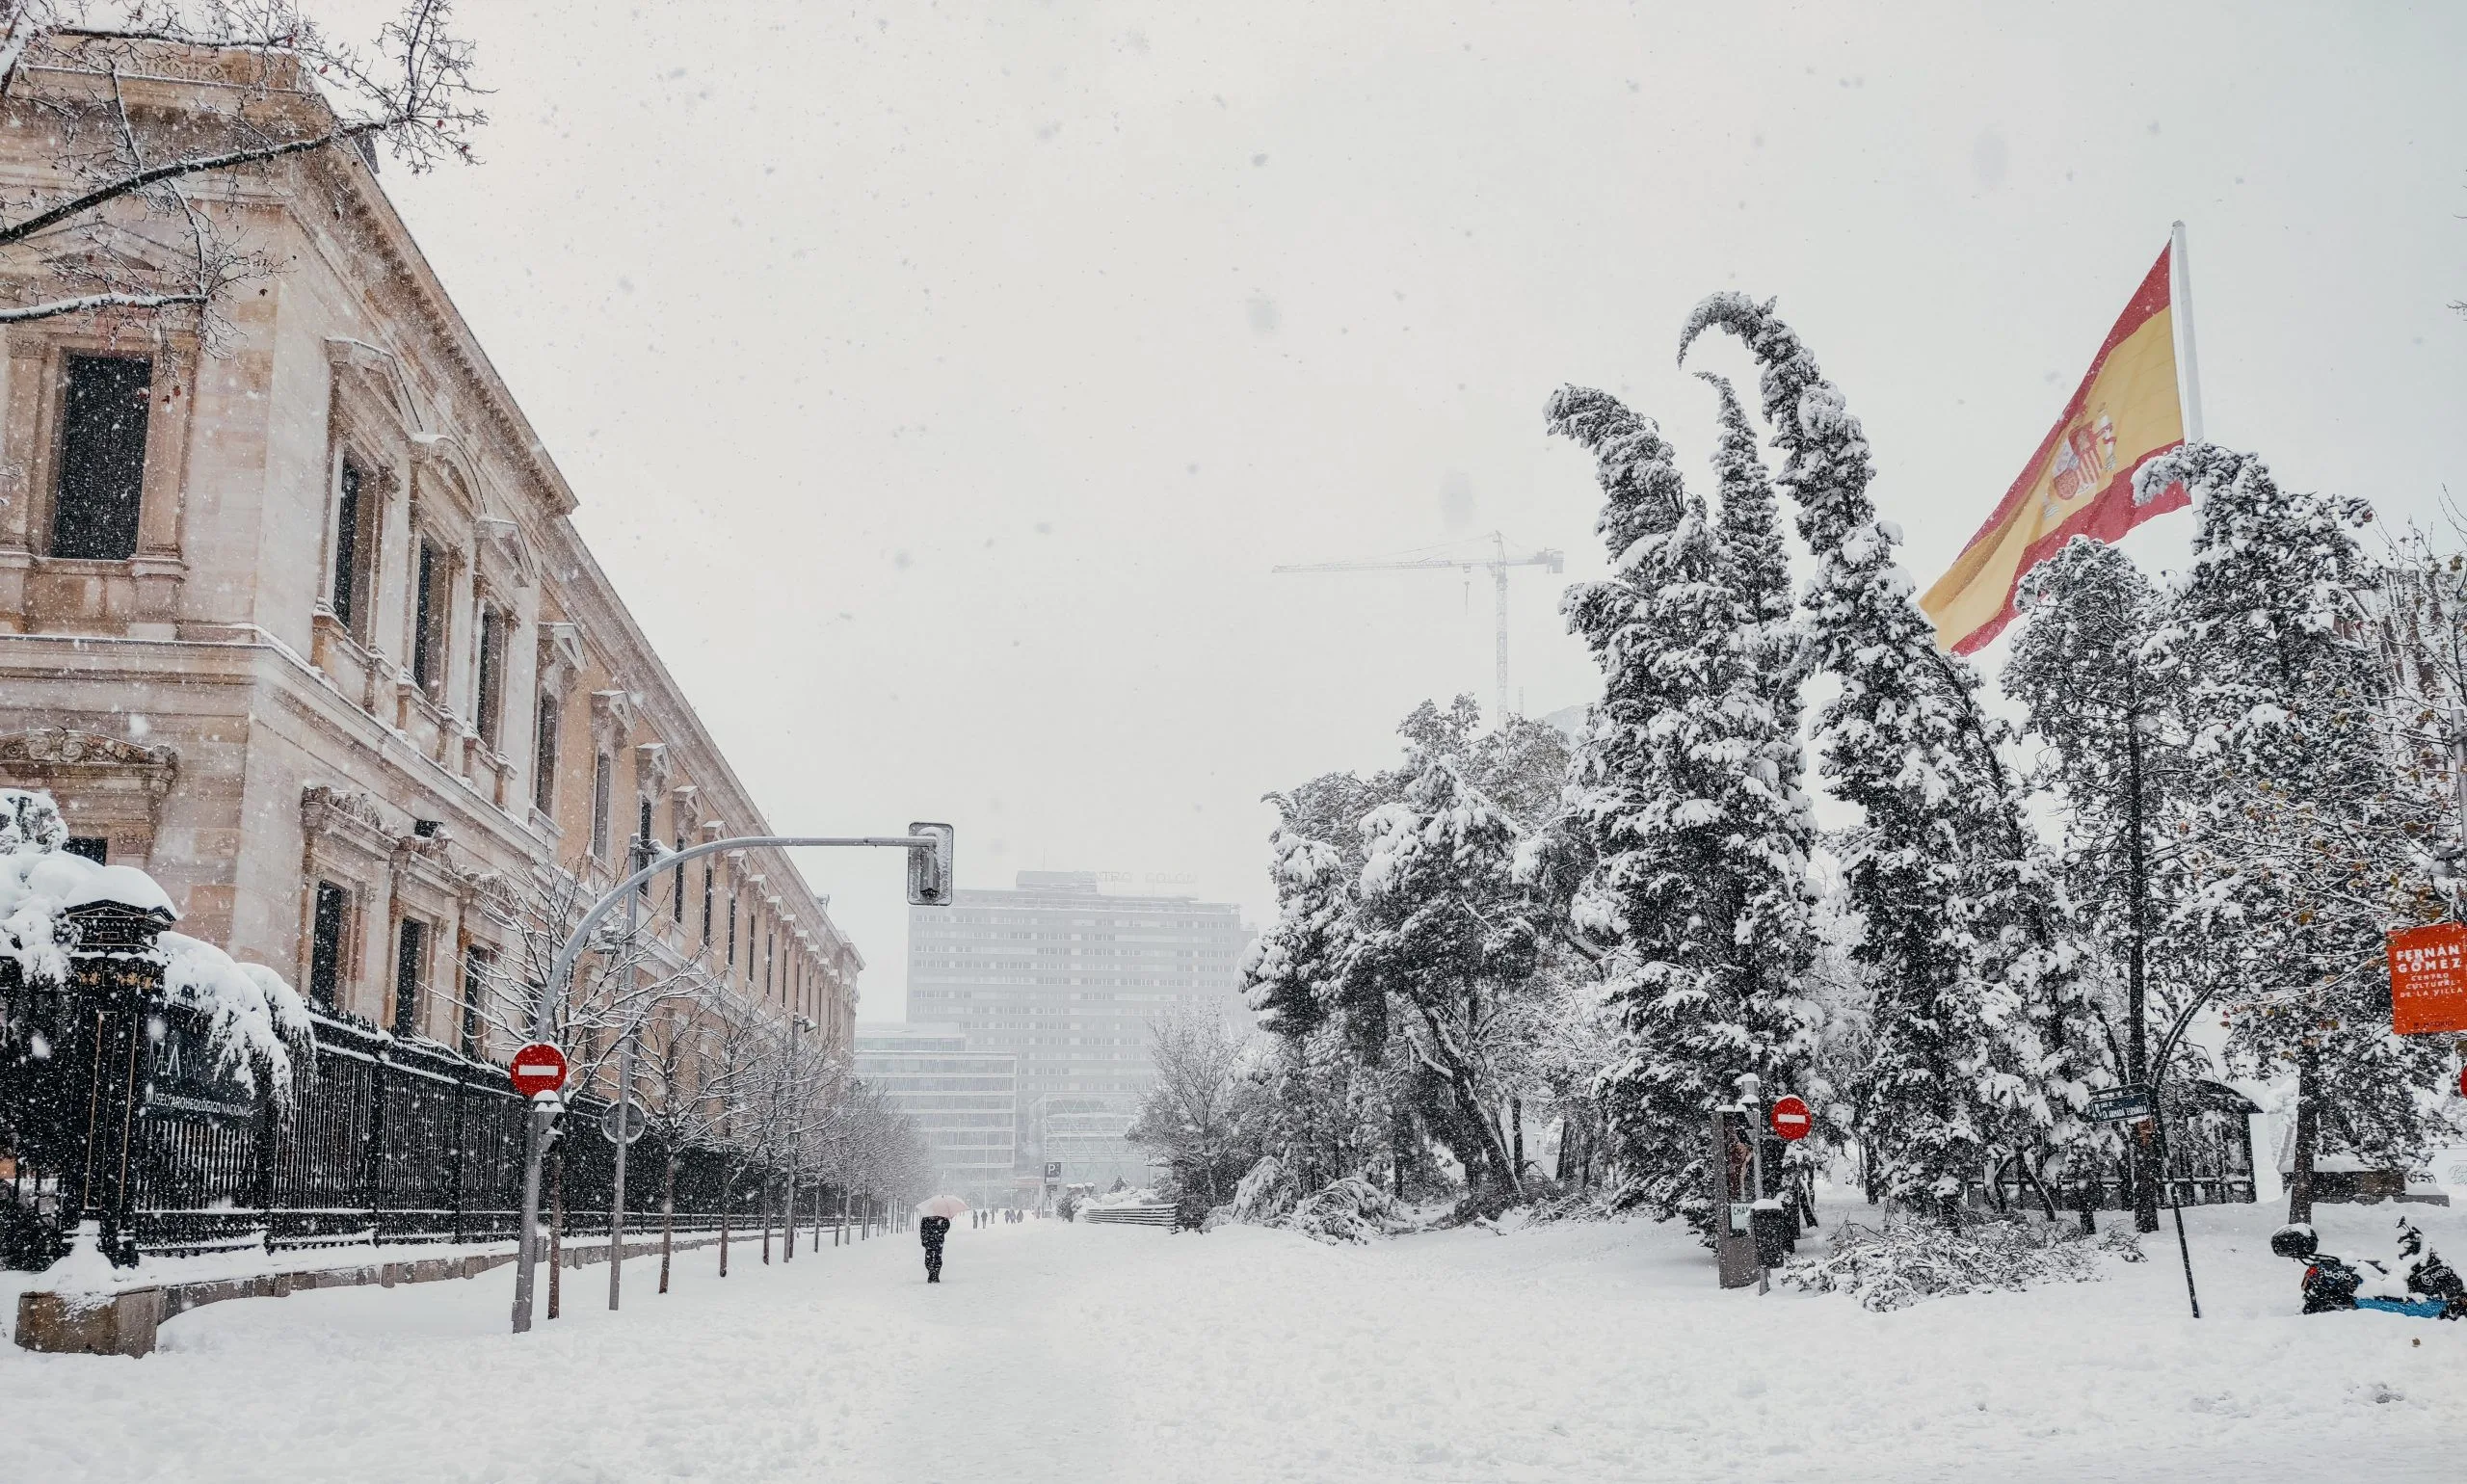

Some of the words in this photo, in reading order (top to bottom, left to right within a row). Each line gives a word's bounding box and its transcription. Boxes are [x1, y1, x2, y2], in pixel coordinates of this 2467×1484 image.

[2406, 980, 2455, 990] CULTURAL
[2434, 988, 2463, 996] VILLA
[145, 1091, 170, 1106] MUSEO
[1048, 1163, 1056, 1175] P
